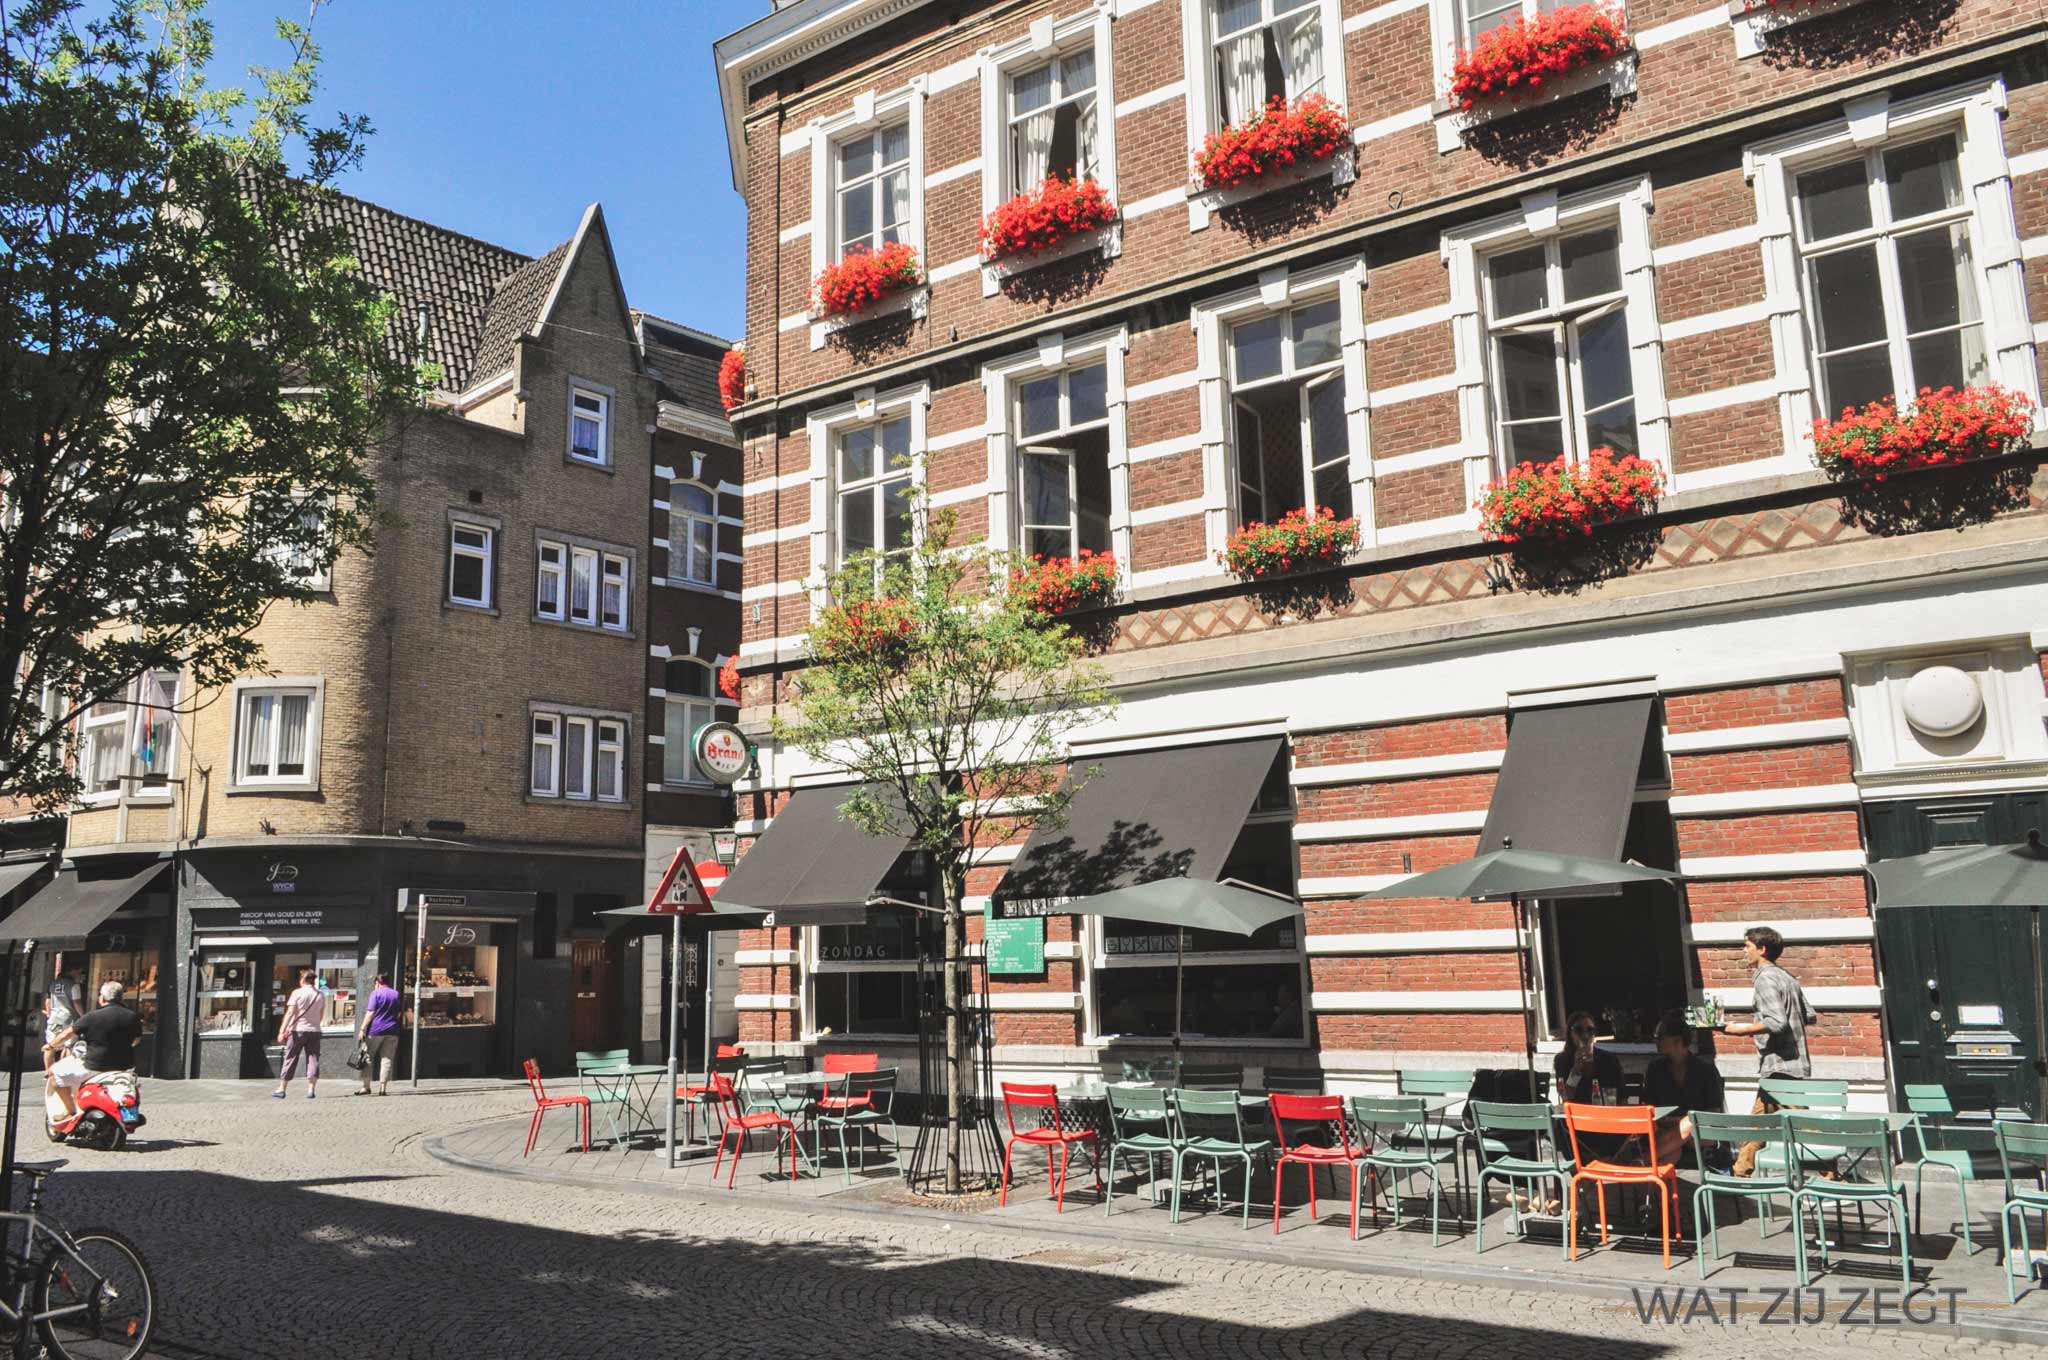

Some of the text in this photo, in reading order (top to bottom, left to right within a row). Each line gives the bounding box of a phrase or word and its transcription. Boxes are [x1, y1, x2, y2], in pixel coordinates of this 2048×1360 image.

[707, 742, 743, 760] Brand
[821, 945, 886, 959] ZONDAG
[54, 983, 65, 993] 21
